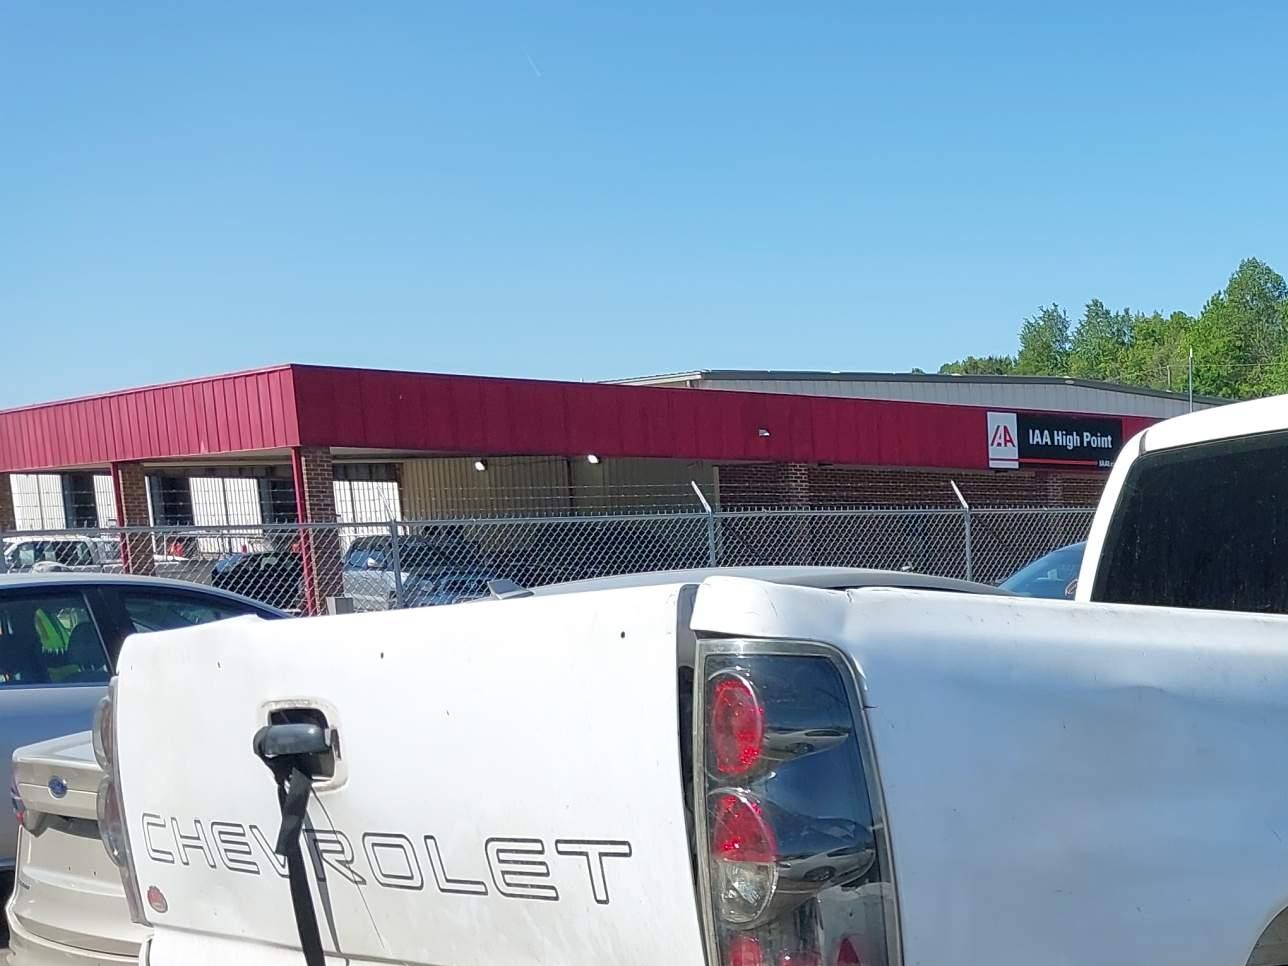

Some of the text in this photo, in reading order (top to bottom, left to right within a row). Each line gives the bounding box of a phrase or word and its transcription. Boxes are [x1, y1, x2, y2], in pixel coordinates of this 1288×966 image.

[1029, 429, 1113, 450] IAA High Point
[141, 812, 632, 905] CHEVROLET
